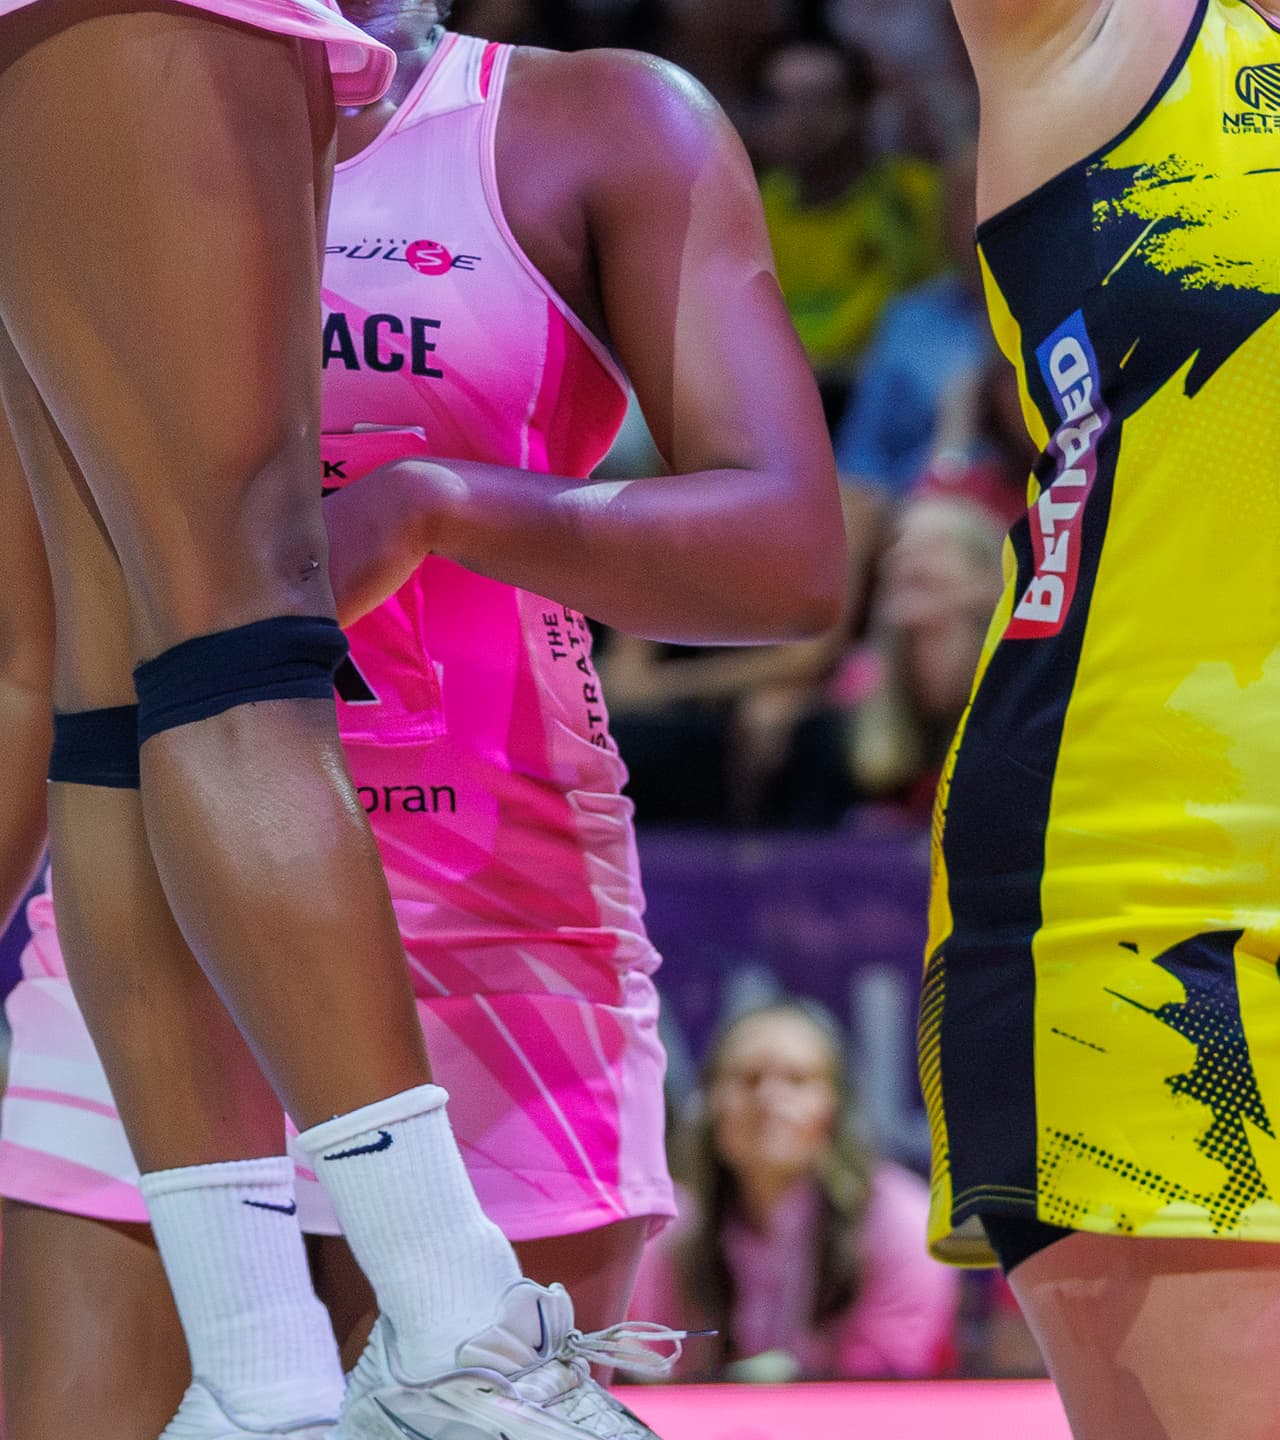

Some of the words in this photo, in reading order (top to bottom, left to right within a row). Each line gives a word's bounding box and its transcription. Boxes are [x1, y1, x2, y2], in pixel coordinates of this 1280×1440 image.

[1222, 126, 1273, 135] SUPER
[322, 313, 444, 379] ACE
[543, 612, 568, 661] THE
